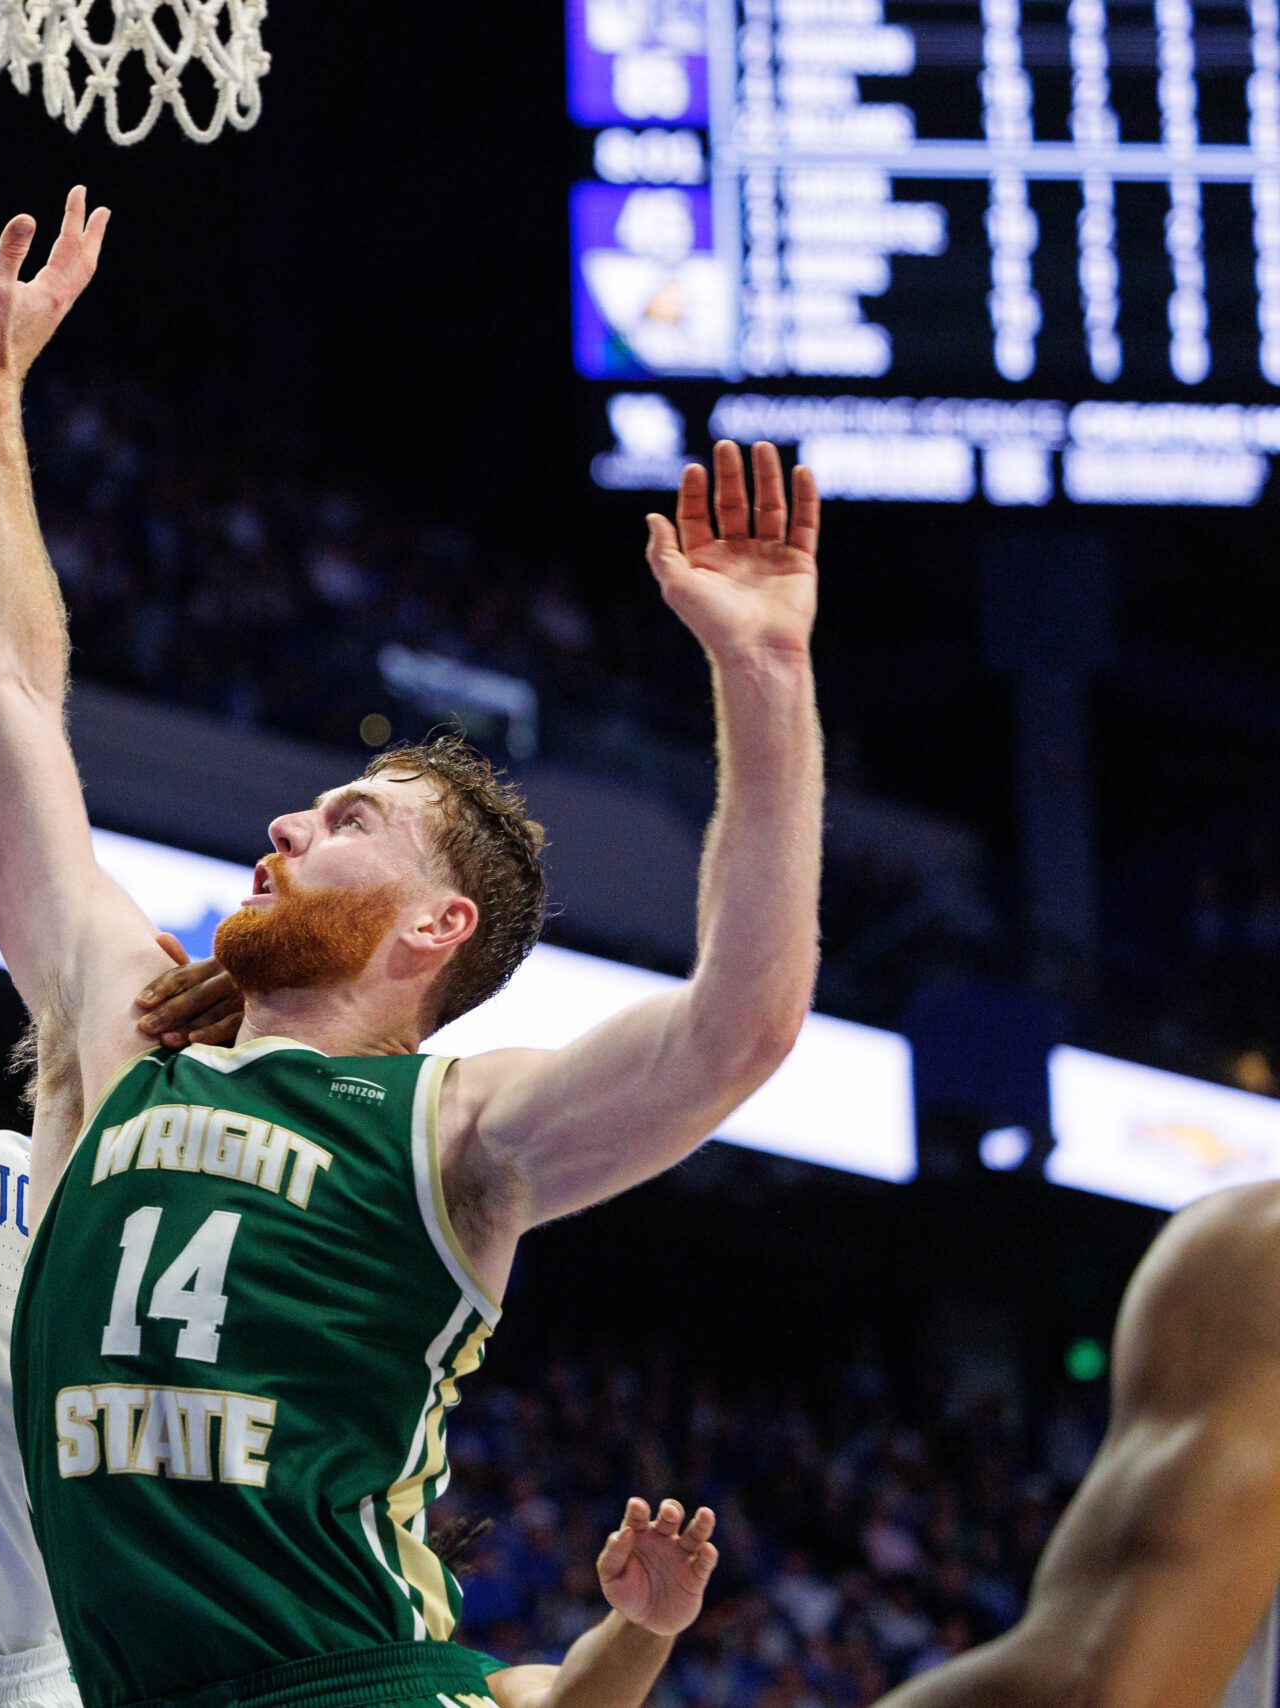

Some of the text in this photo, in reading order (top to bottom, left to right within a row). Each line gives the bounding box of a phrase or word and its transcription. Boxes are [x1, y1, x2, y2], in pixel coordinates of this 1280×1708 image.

[330, 1082, 386, 1100] HORIZON
[91, 1104, 334, 1211] WRIGHT
[100, 1206, 242, 1364] 14
[55, 1382, 278, 1488] STATE
